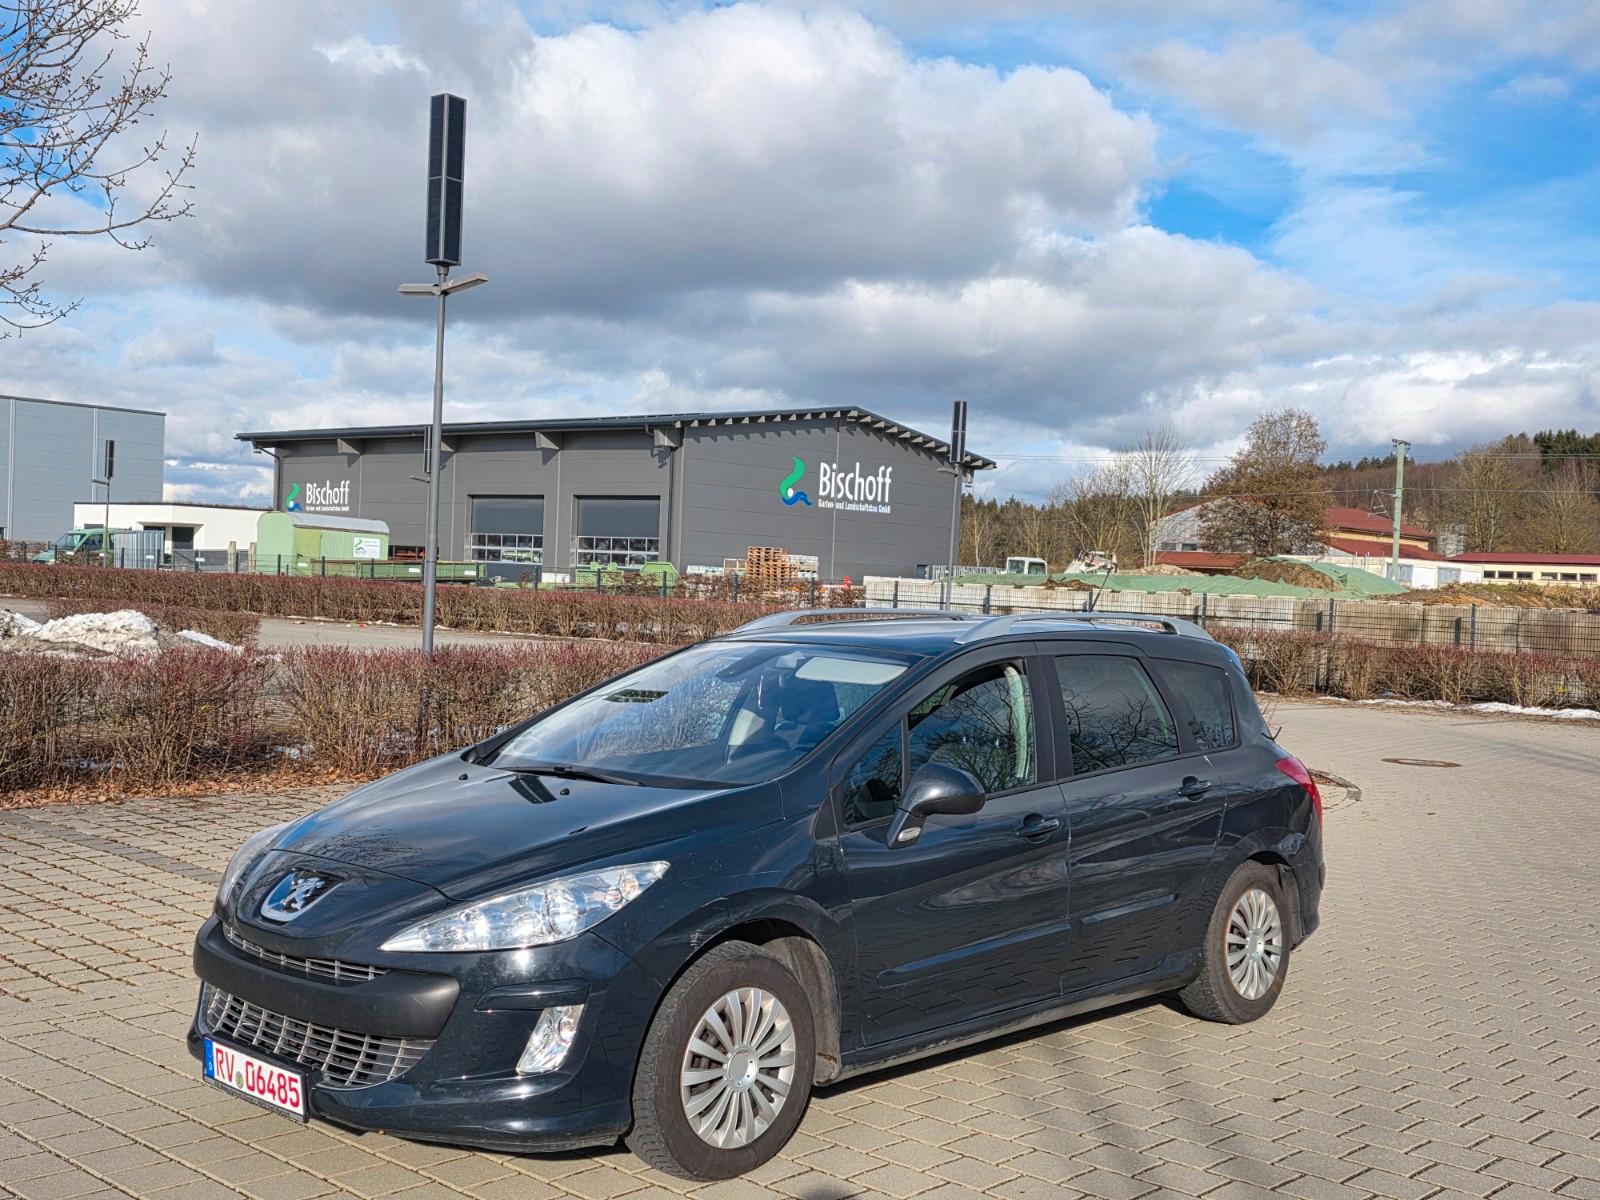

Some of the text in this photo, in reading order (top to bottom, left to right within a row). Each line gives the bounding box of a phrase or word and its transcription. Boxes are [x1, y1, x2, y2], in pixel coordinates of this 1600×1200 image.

[306, 480, 350, 505] Bischoff
[819, 462, 892, 502] Bischoff
[215, 1047, 234, 1083] RV
[245, 1060, 300, 1108] 06485
